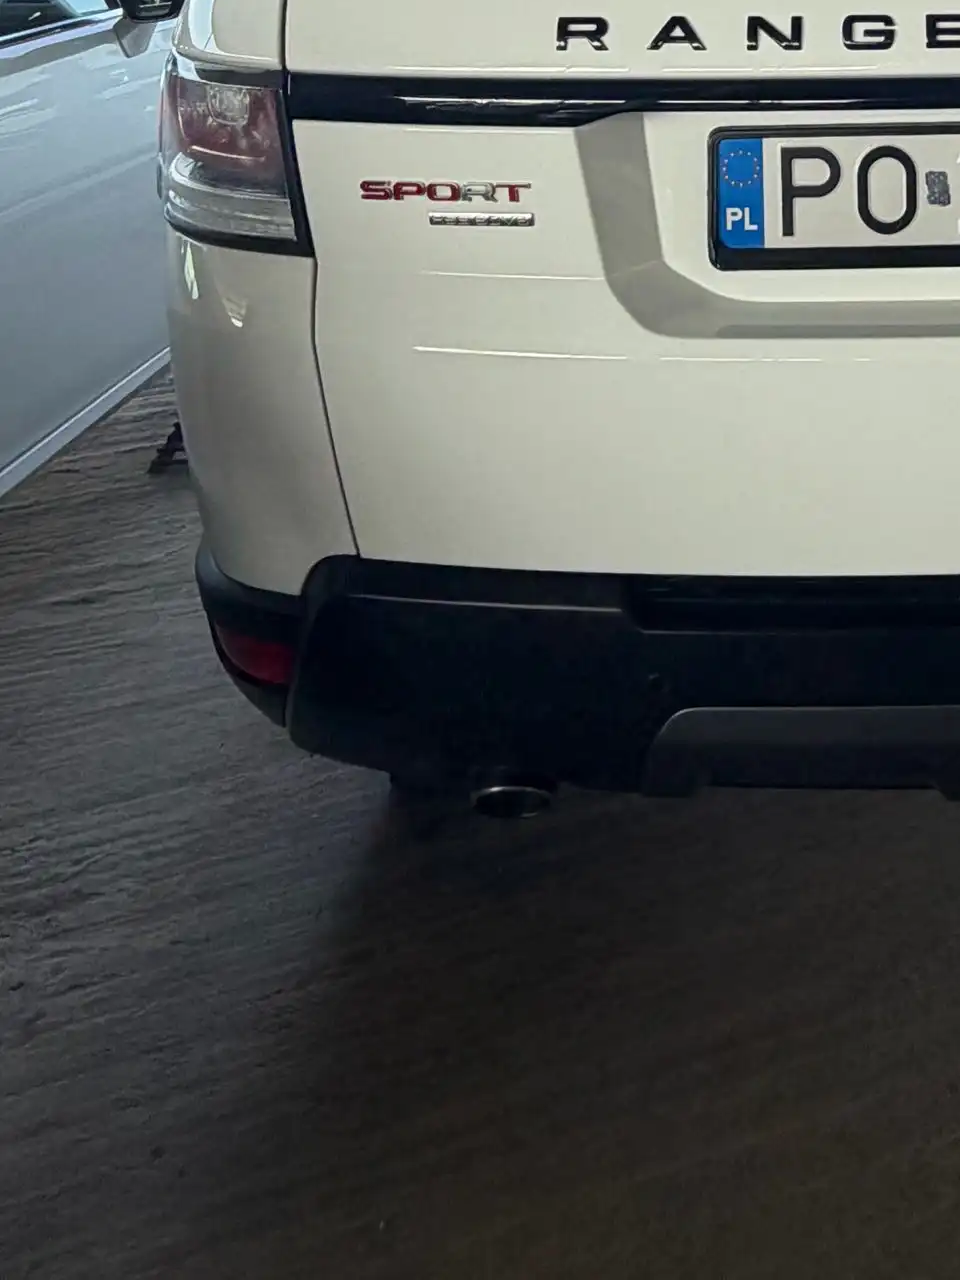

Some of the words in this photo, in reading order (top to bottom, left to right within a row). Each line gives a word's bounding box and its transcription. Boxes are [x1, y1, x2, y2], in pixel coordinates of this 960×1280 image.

[359, 180, 532, 203] SPORT
[780, 145, 918, 237] PO
[725, 207, 759, 231] PL
